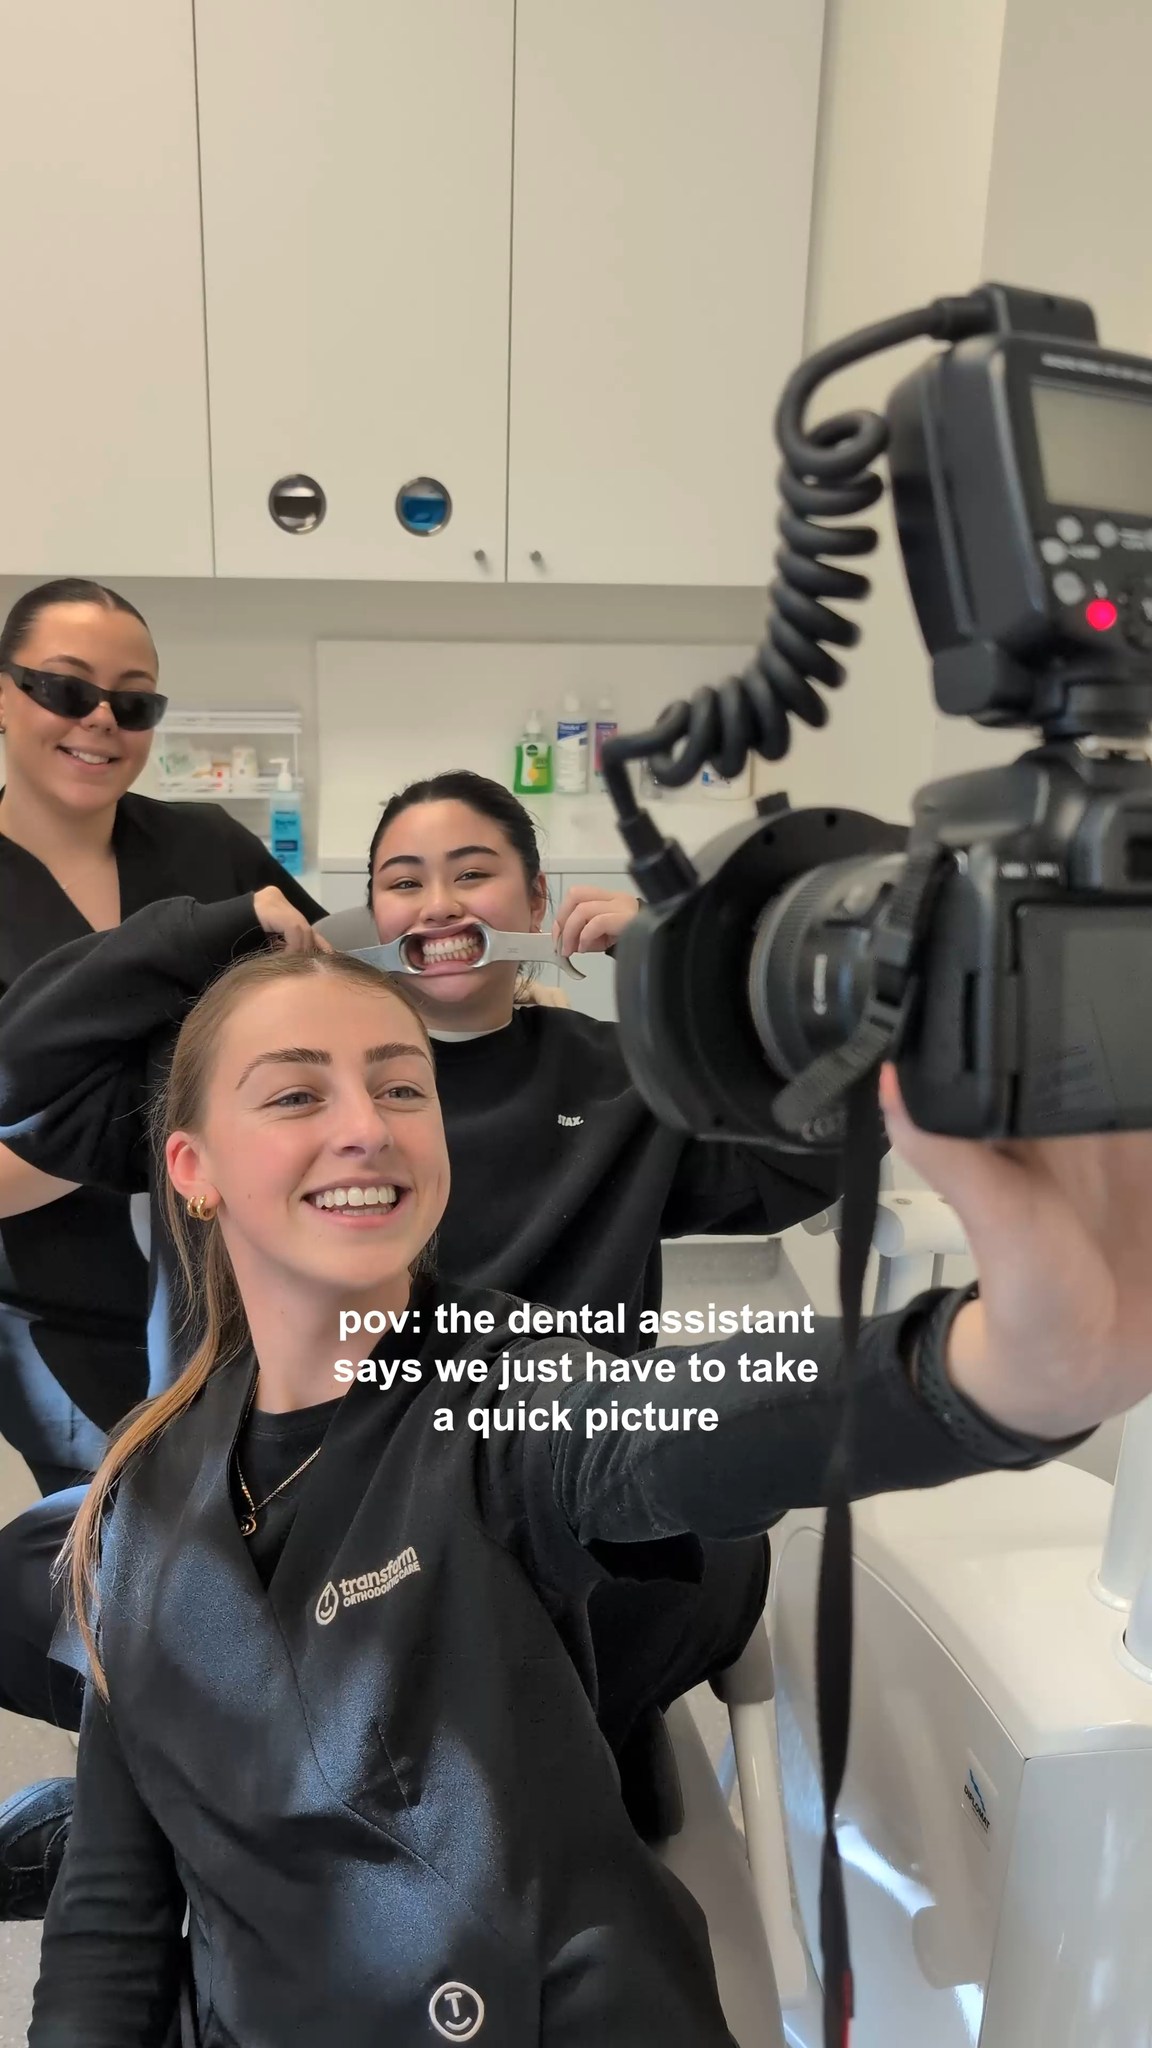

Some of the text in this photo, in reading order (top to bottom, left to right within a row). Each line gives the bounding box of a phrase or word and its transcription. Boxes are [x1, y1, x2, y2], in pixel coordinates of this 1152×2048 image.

[339, 1546, 418, 1597] transform
[343, 1560, 421, 1607] ORTHODONTIC CARE
[963, 1784, 990, 1829] DIPLOMAT
